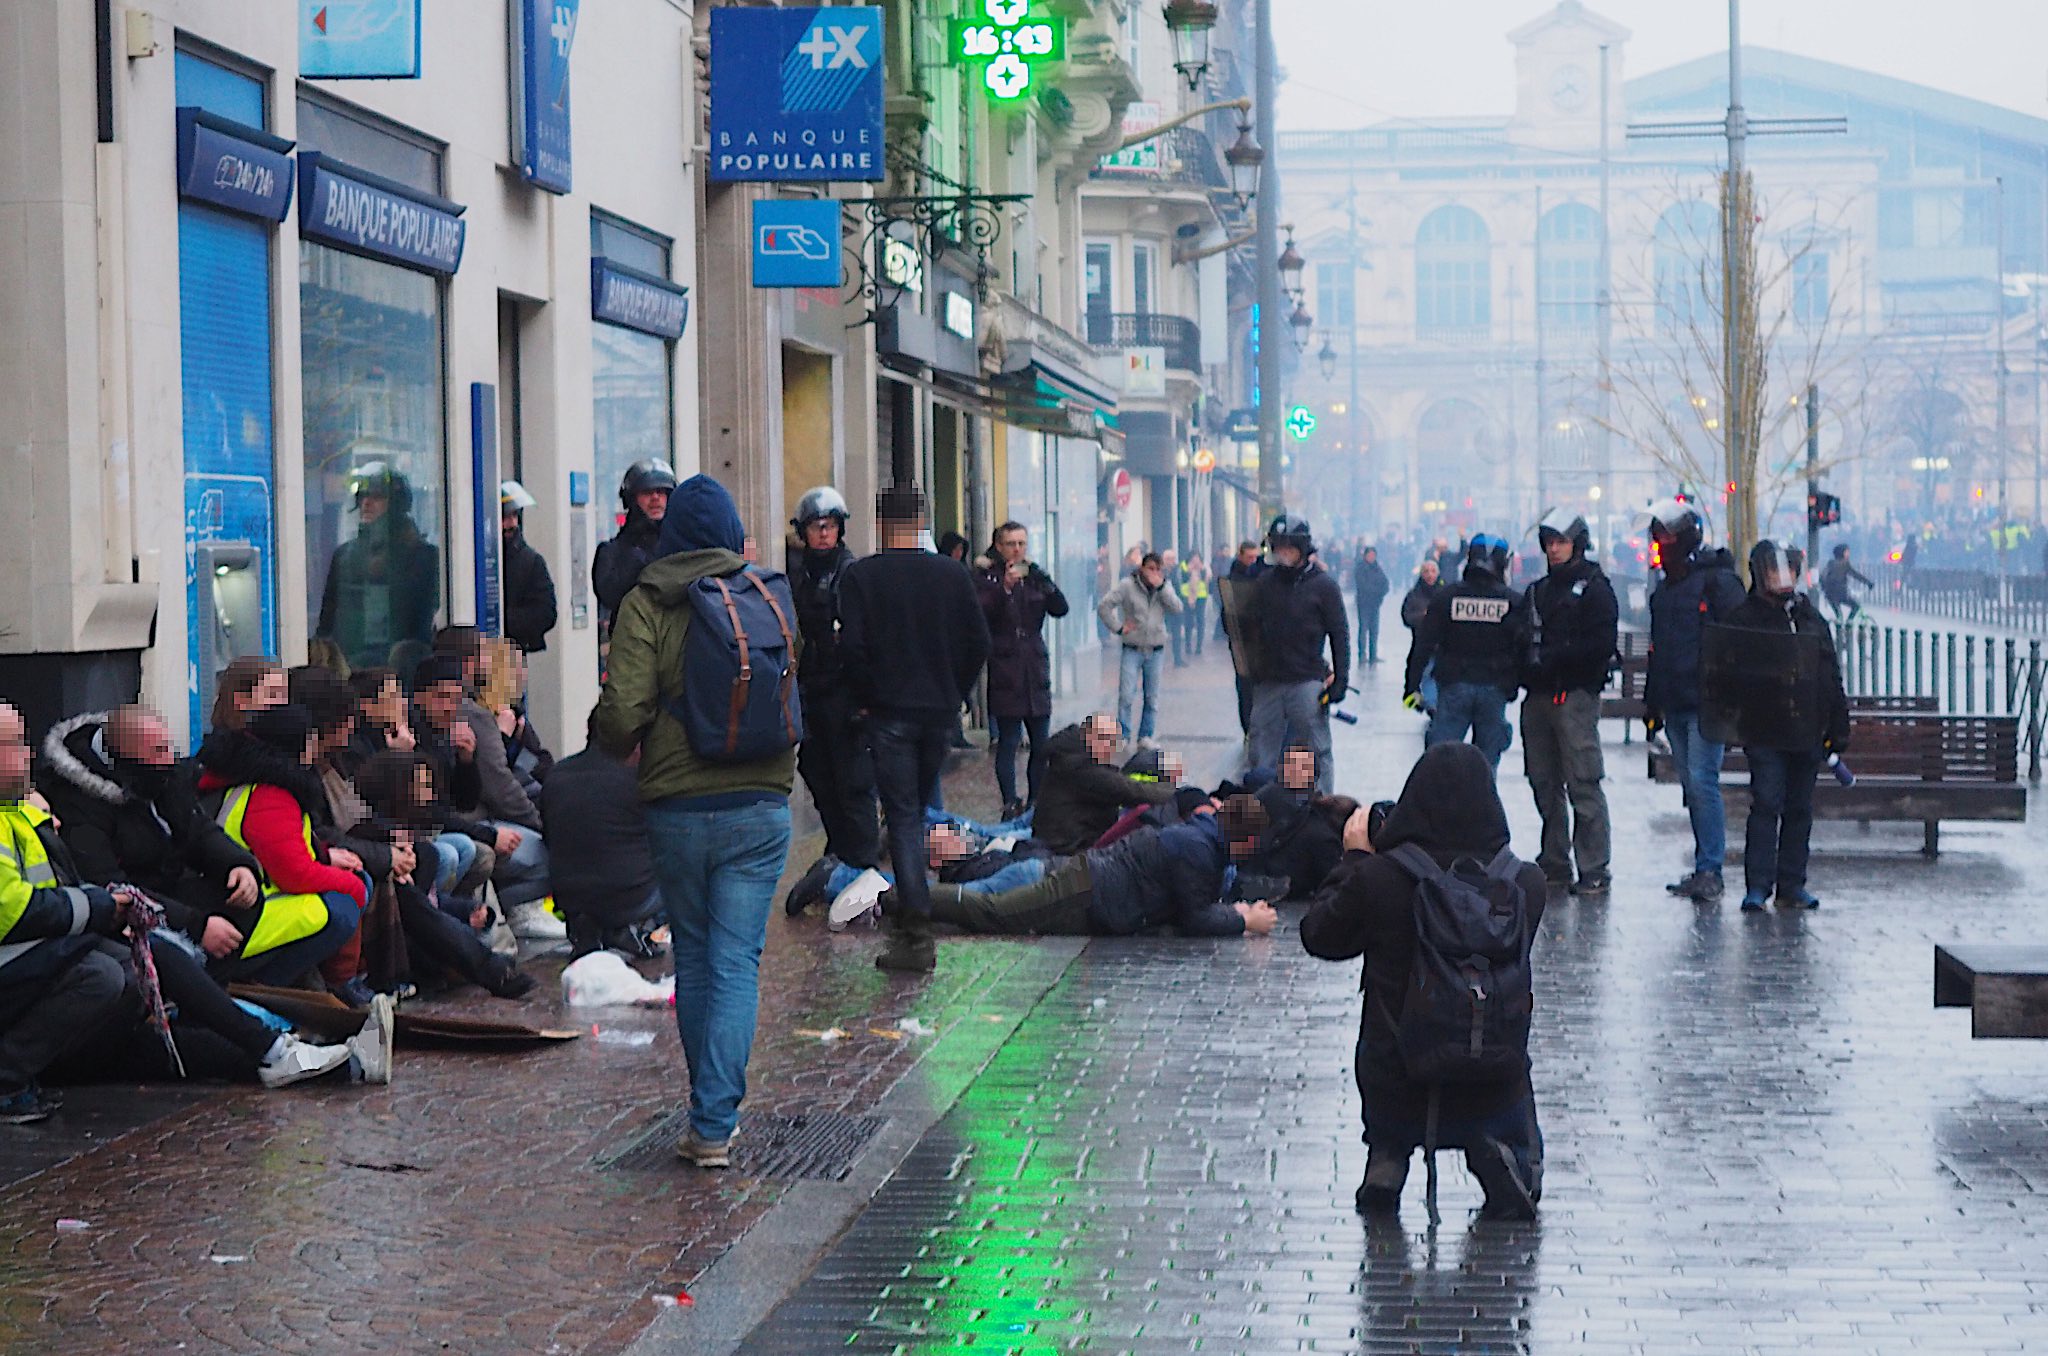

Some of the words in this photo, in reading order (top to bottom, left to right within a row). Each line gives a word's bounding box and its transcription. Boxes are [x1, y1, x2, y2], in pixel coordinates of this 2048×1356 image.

[962, 24, 1053, 55] 16:43
[720, 129, 870, 146] BANQUE
[720, 152, 873, 170] POPULAIRE
[234, 159, 274, 198] 24h/24h
[324, 180, 389, 245] BANQUE
[388, 203, 460, 264] POPULAIRE
[1455, 602, 1505, 619] POLICE
